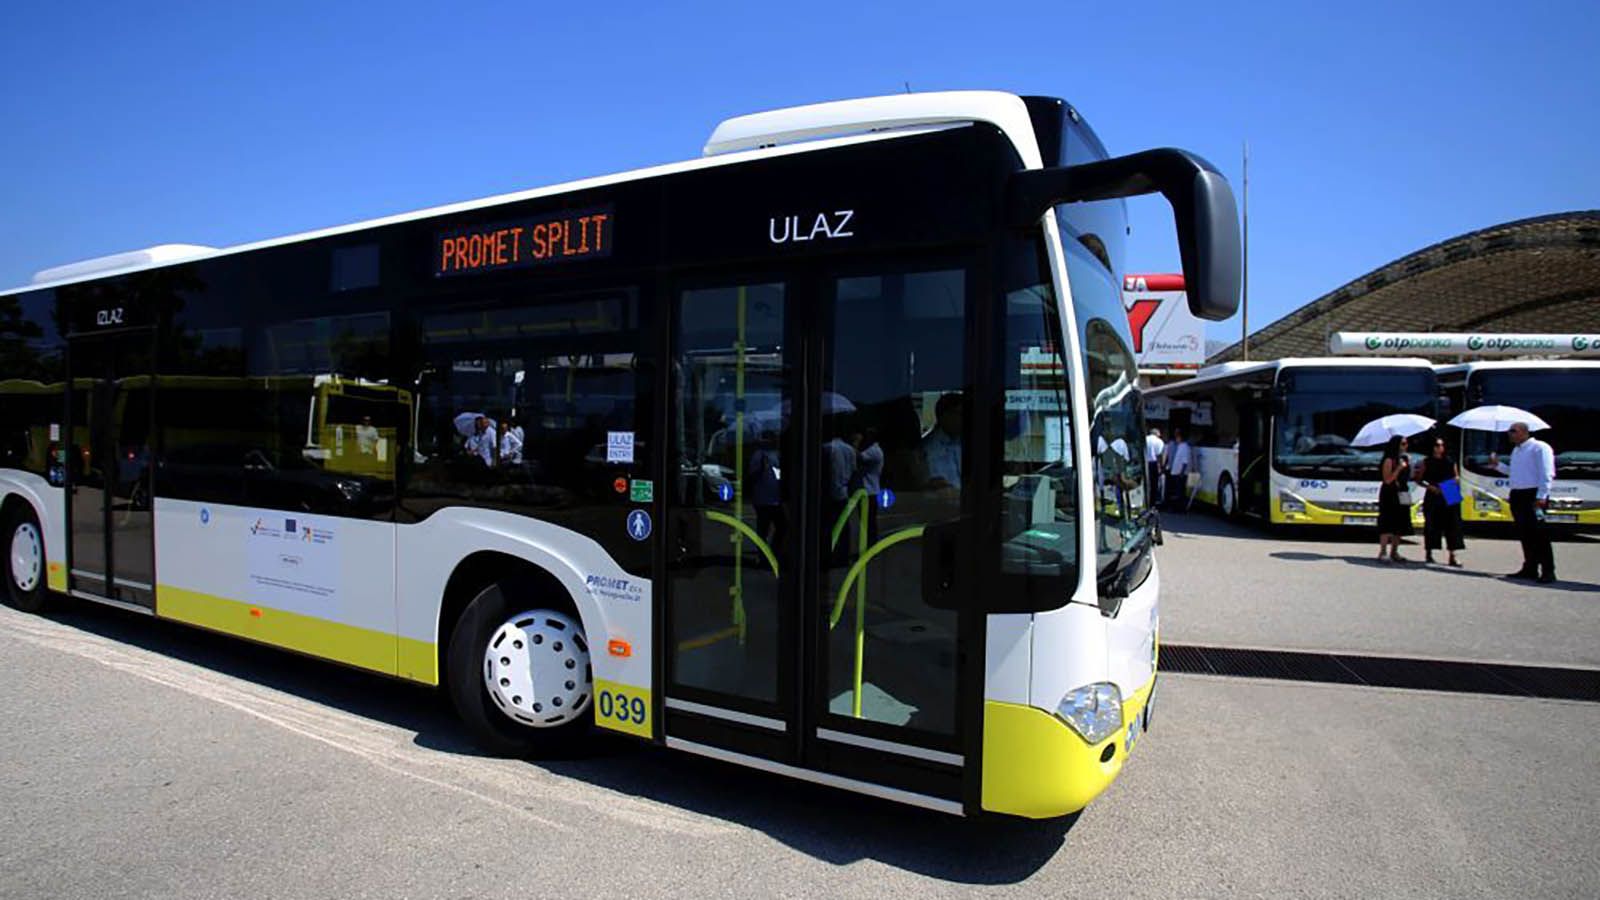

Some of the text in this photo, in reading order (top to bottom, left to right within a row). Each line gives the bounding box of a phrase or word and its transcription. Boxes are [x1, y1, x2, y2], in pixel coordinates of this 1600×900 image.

[441, 214, 608, 272] PROMET SPLIT
[768, 210, 855, 244] ULAZ
[586, 575, 629, 590] PROMET
[599, 690, 646, 725] 039
